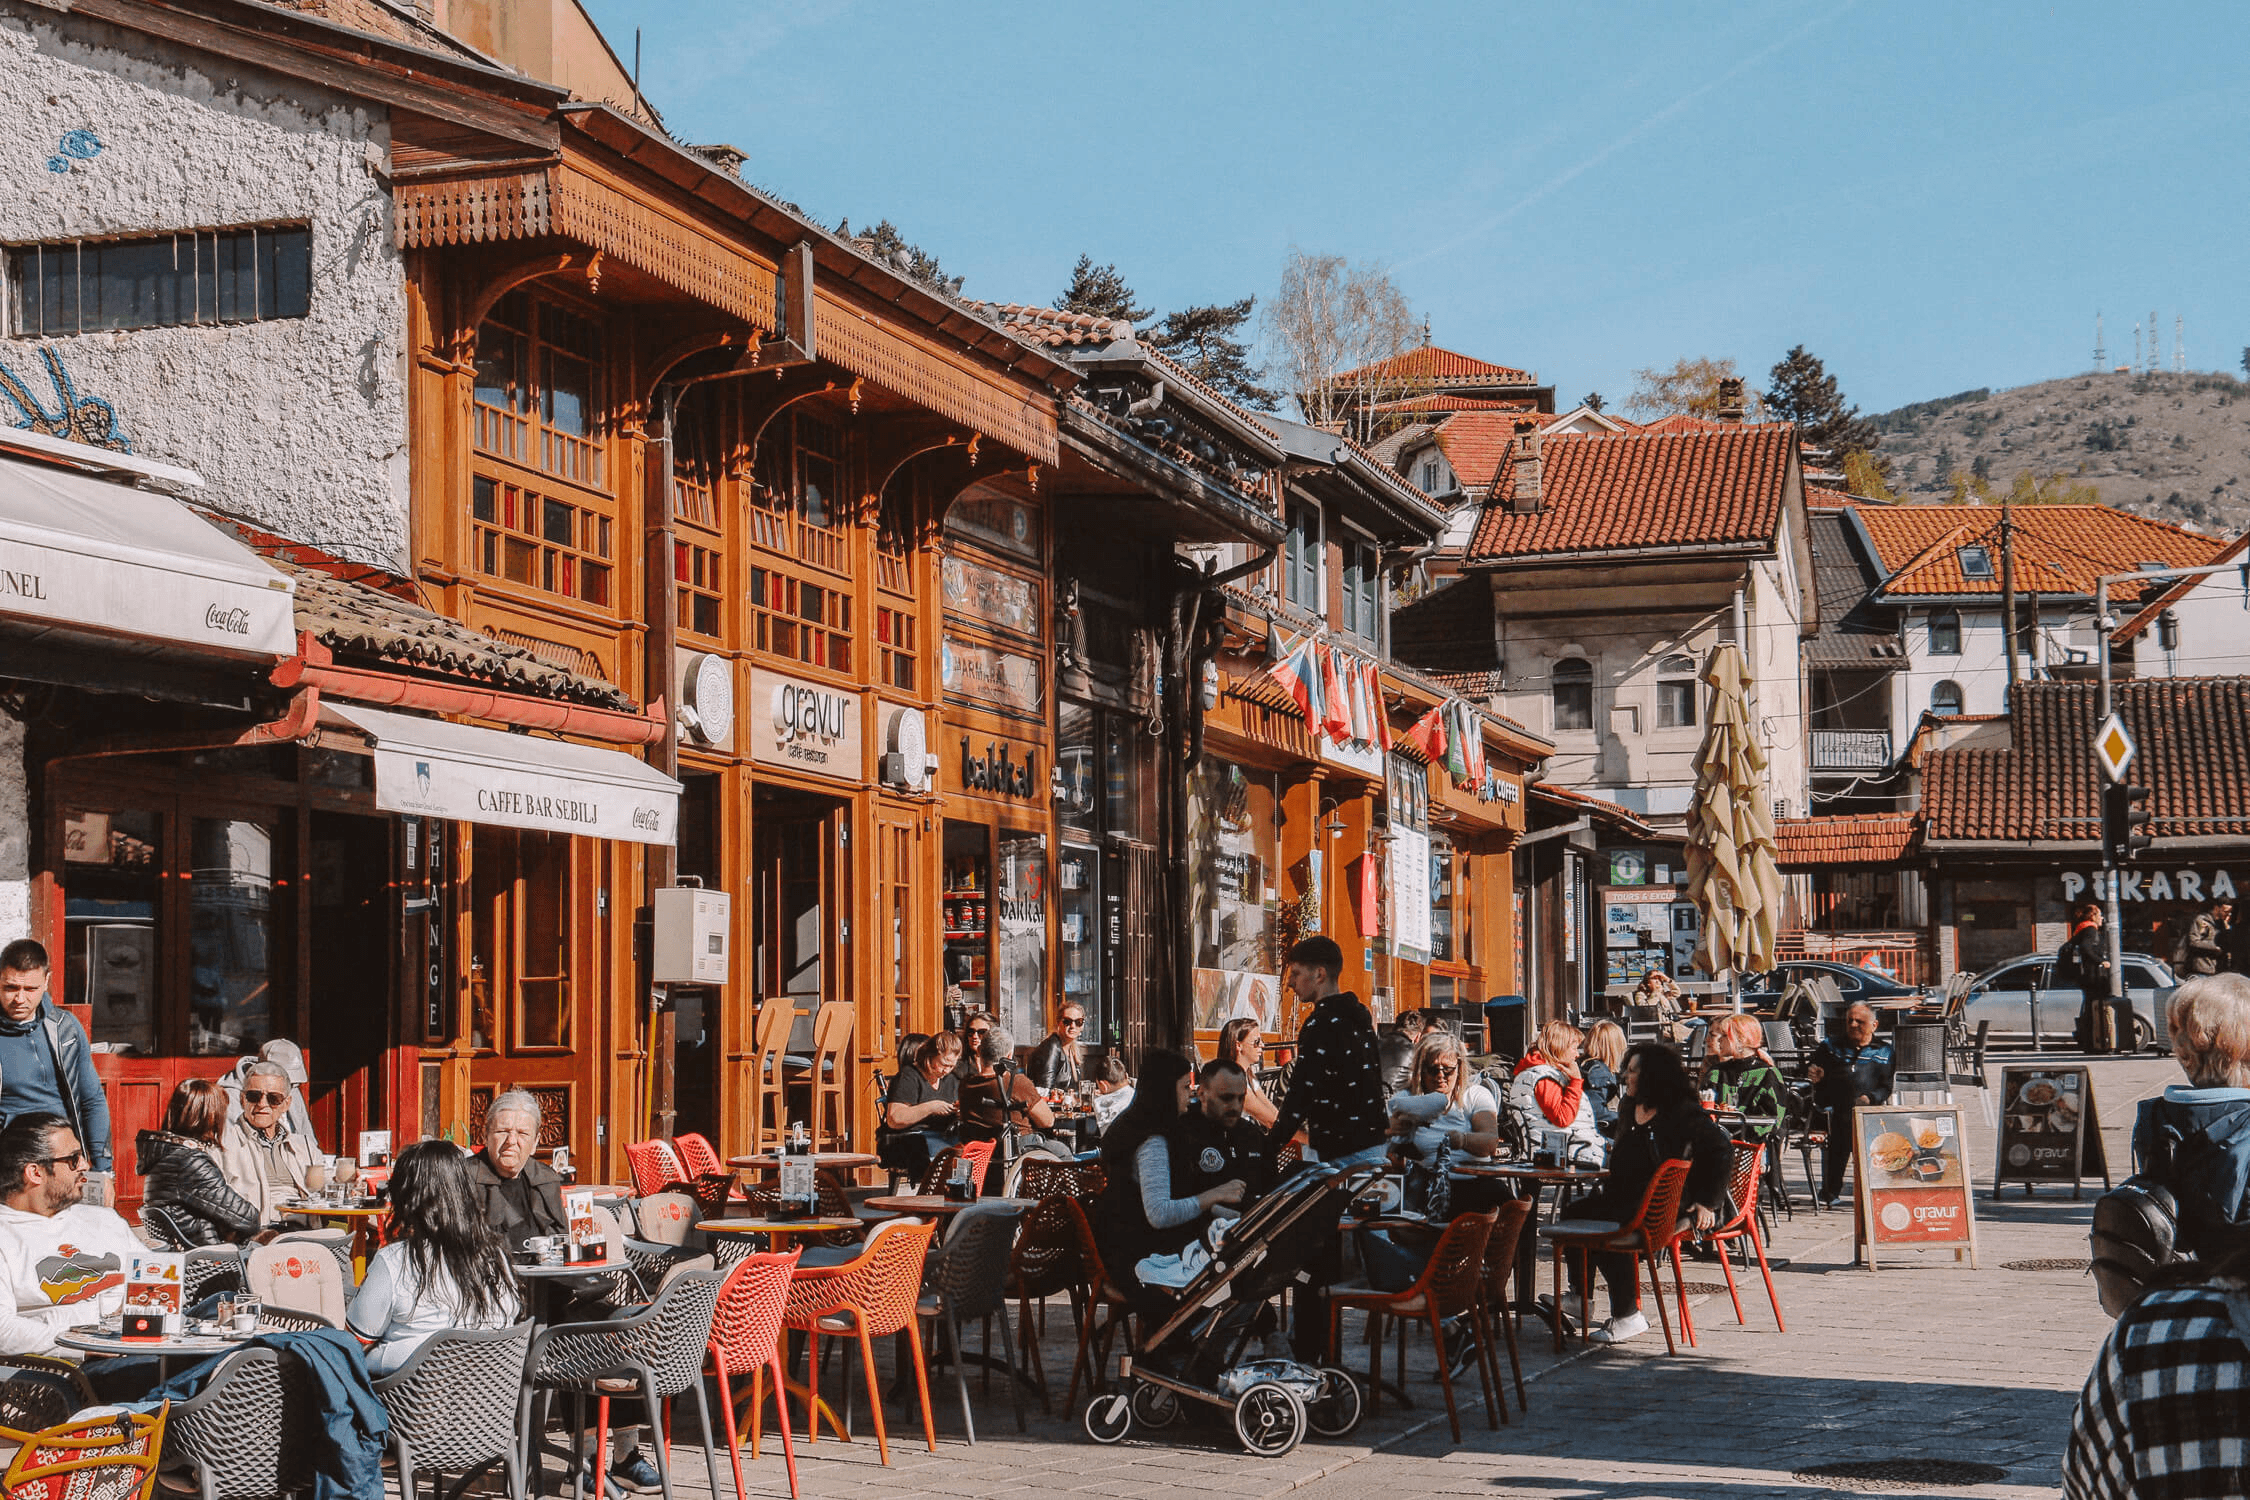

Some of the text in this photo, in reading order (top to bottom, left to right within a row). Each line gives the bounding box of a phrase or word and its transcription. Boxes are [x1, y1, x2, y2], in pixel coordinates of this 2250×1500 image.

[777, 684, 850, 743] gravur
[960, 735, 1035, 799] bakkal
[478, 789, 522, 814] CAFFE
[526, 794, 553, 817] BAR
[555, 798, 598, 824] SEBILJ
[1496, 779, 1519, 804] COFFEE
[429, 822, 441, 1026] HANGE
[2033, 1147, 2070, 1160] gravur
[1913, 1205, 1960, 1222] gravur
